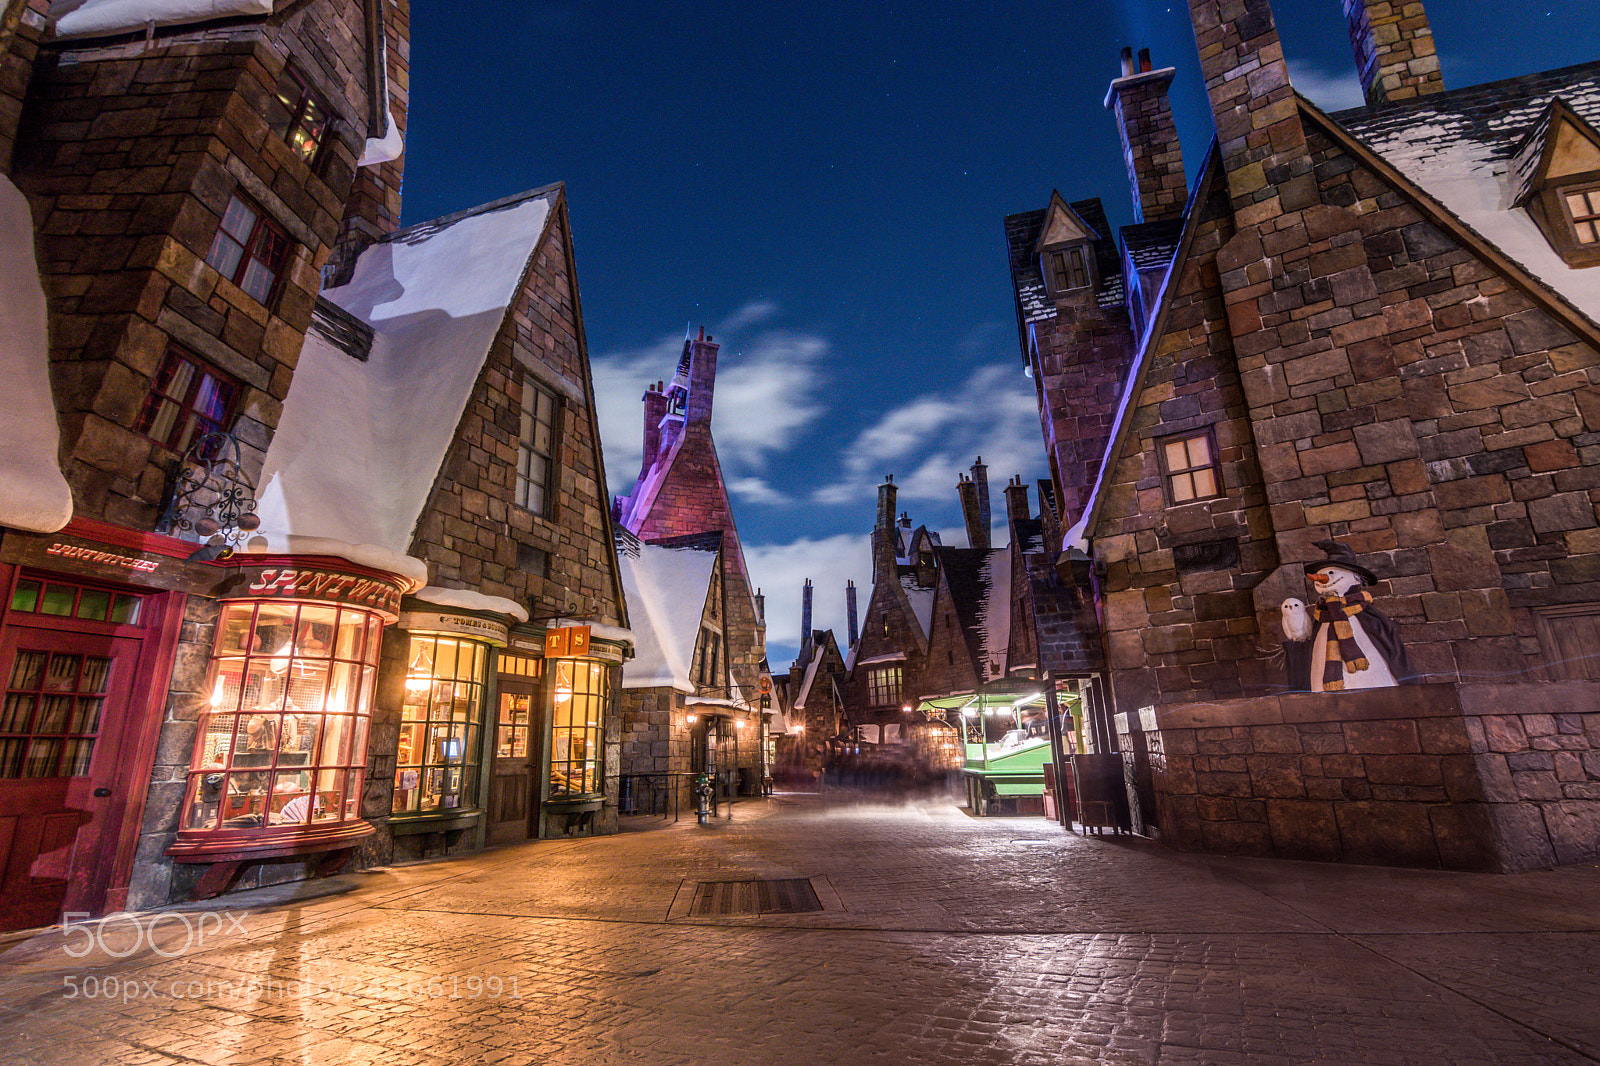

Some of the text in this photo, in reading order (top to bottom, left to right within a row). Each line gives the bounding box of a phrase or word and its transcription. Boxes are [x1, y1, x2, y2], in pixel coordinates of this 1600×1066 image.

[46, 543, 159, 572] SPINTWITCHES
[248, 569, 398, 610] SPINTWITC
[549, 633, 584, 648] T S
